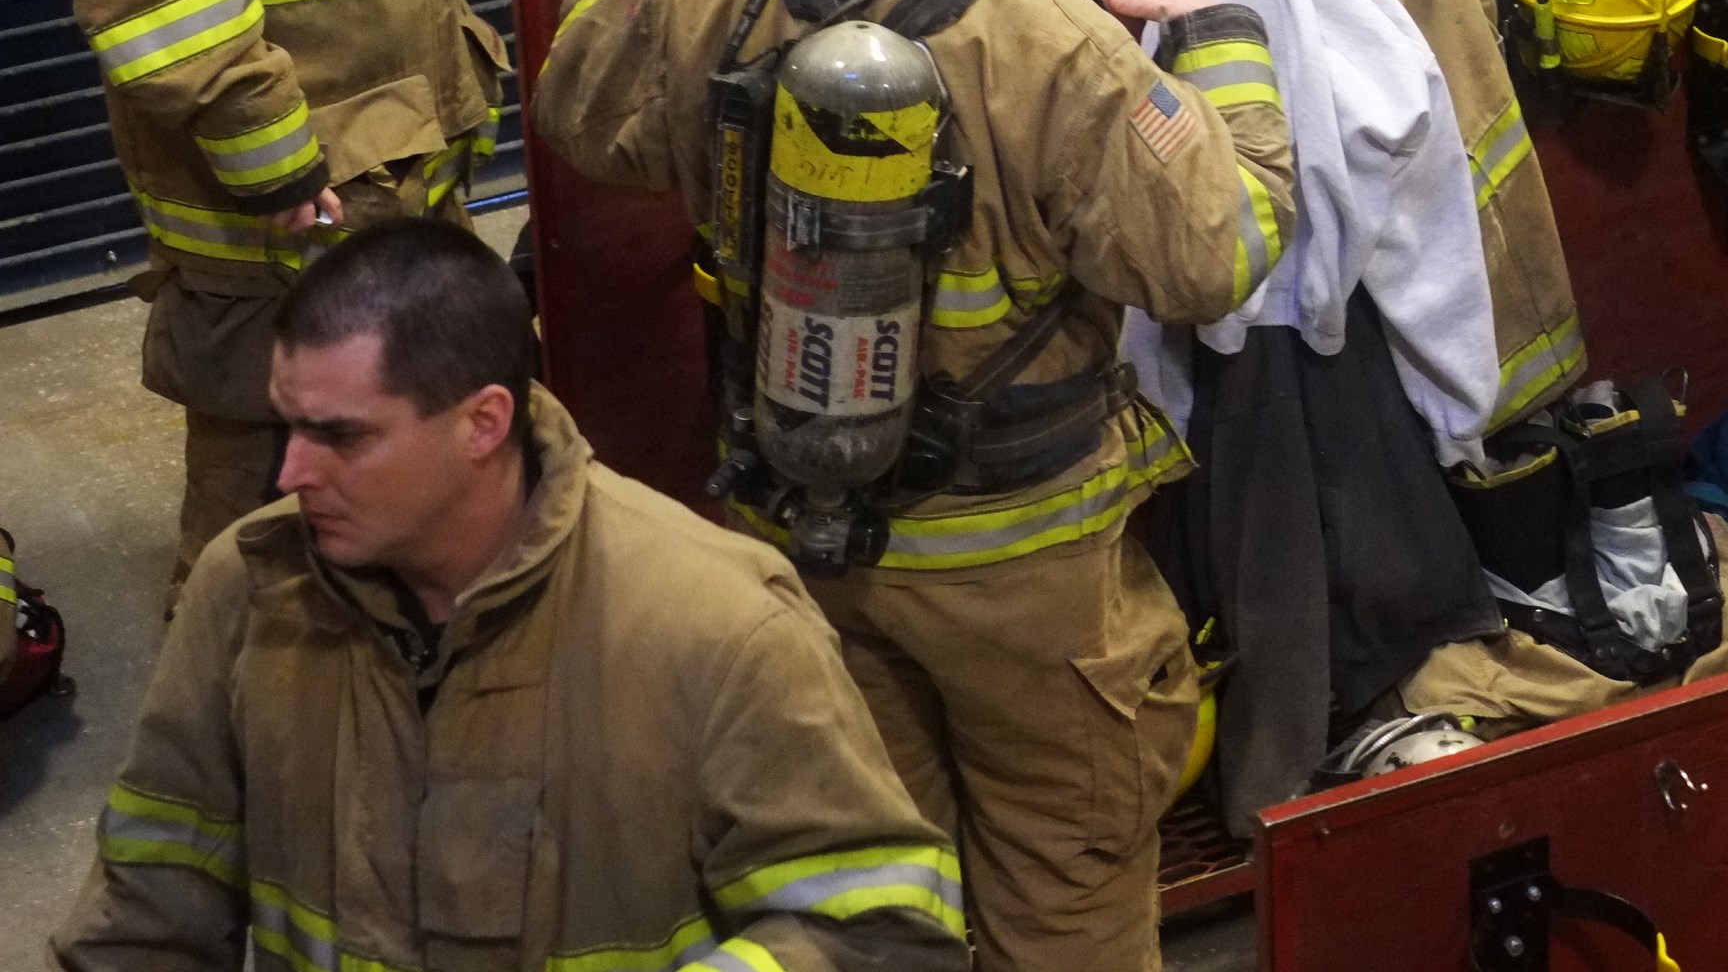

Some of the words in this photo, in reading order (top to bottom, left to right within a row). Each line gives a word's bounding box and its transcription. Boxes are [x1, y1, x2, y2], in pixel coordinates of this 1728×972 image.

[799, 316, 834, 408] SCOTT
[852, 337, 870, 401] AIR-PAK
[870, 319, 901, 403] SCOTT
